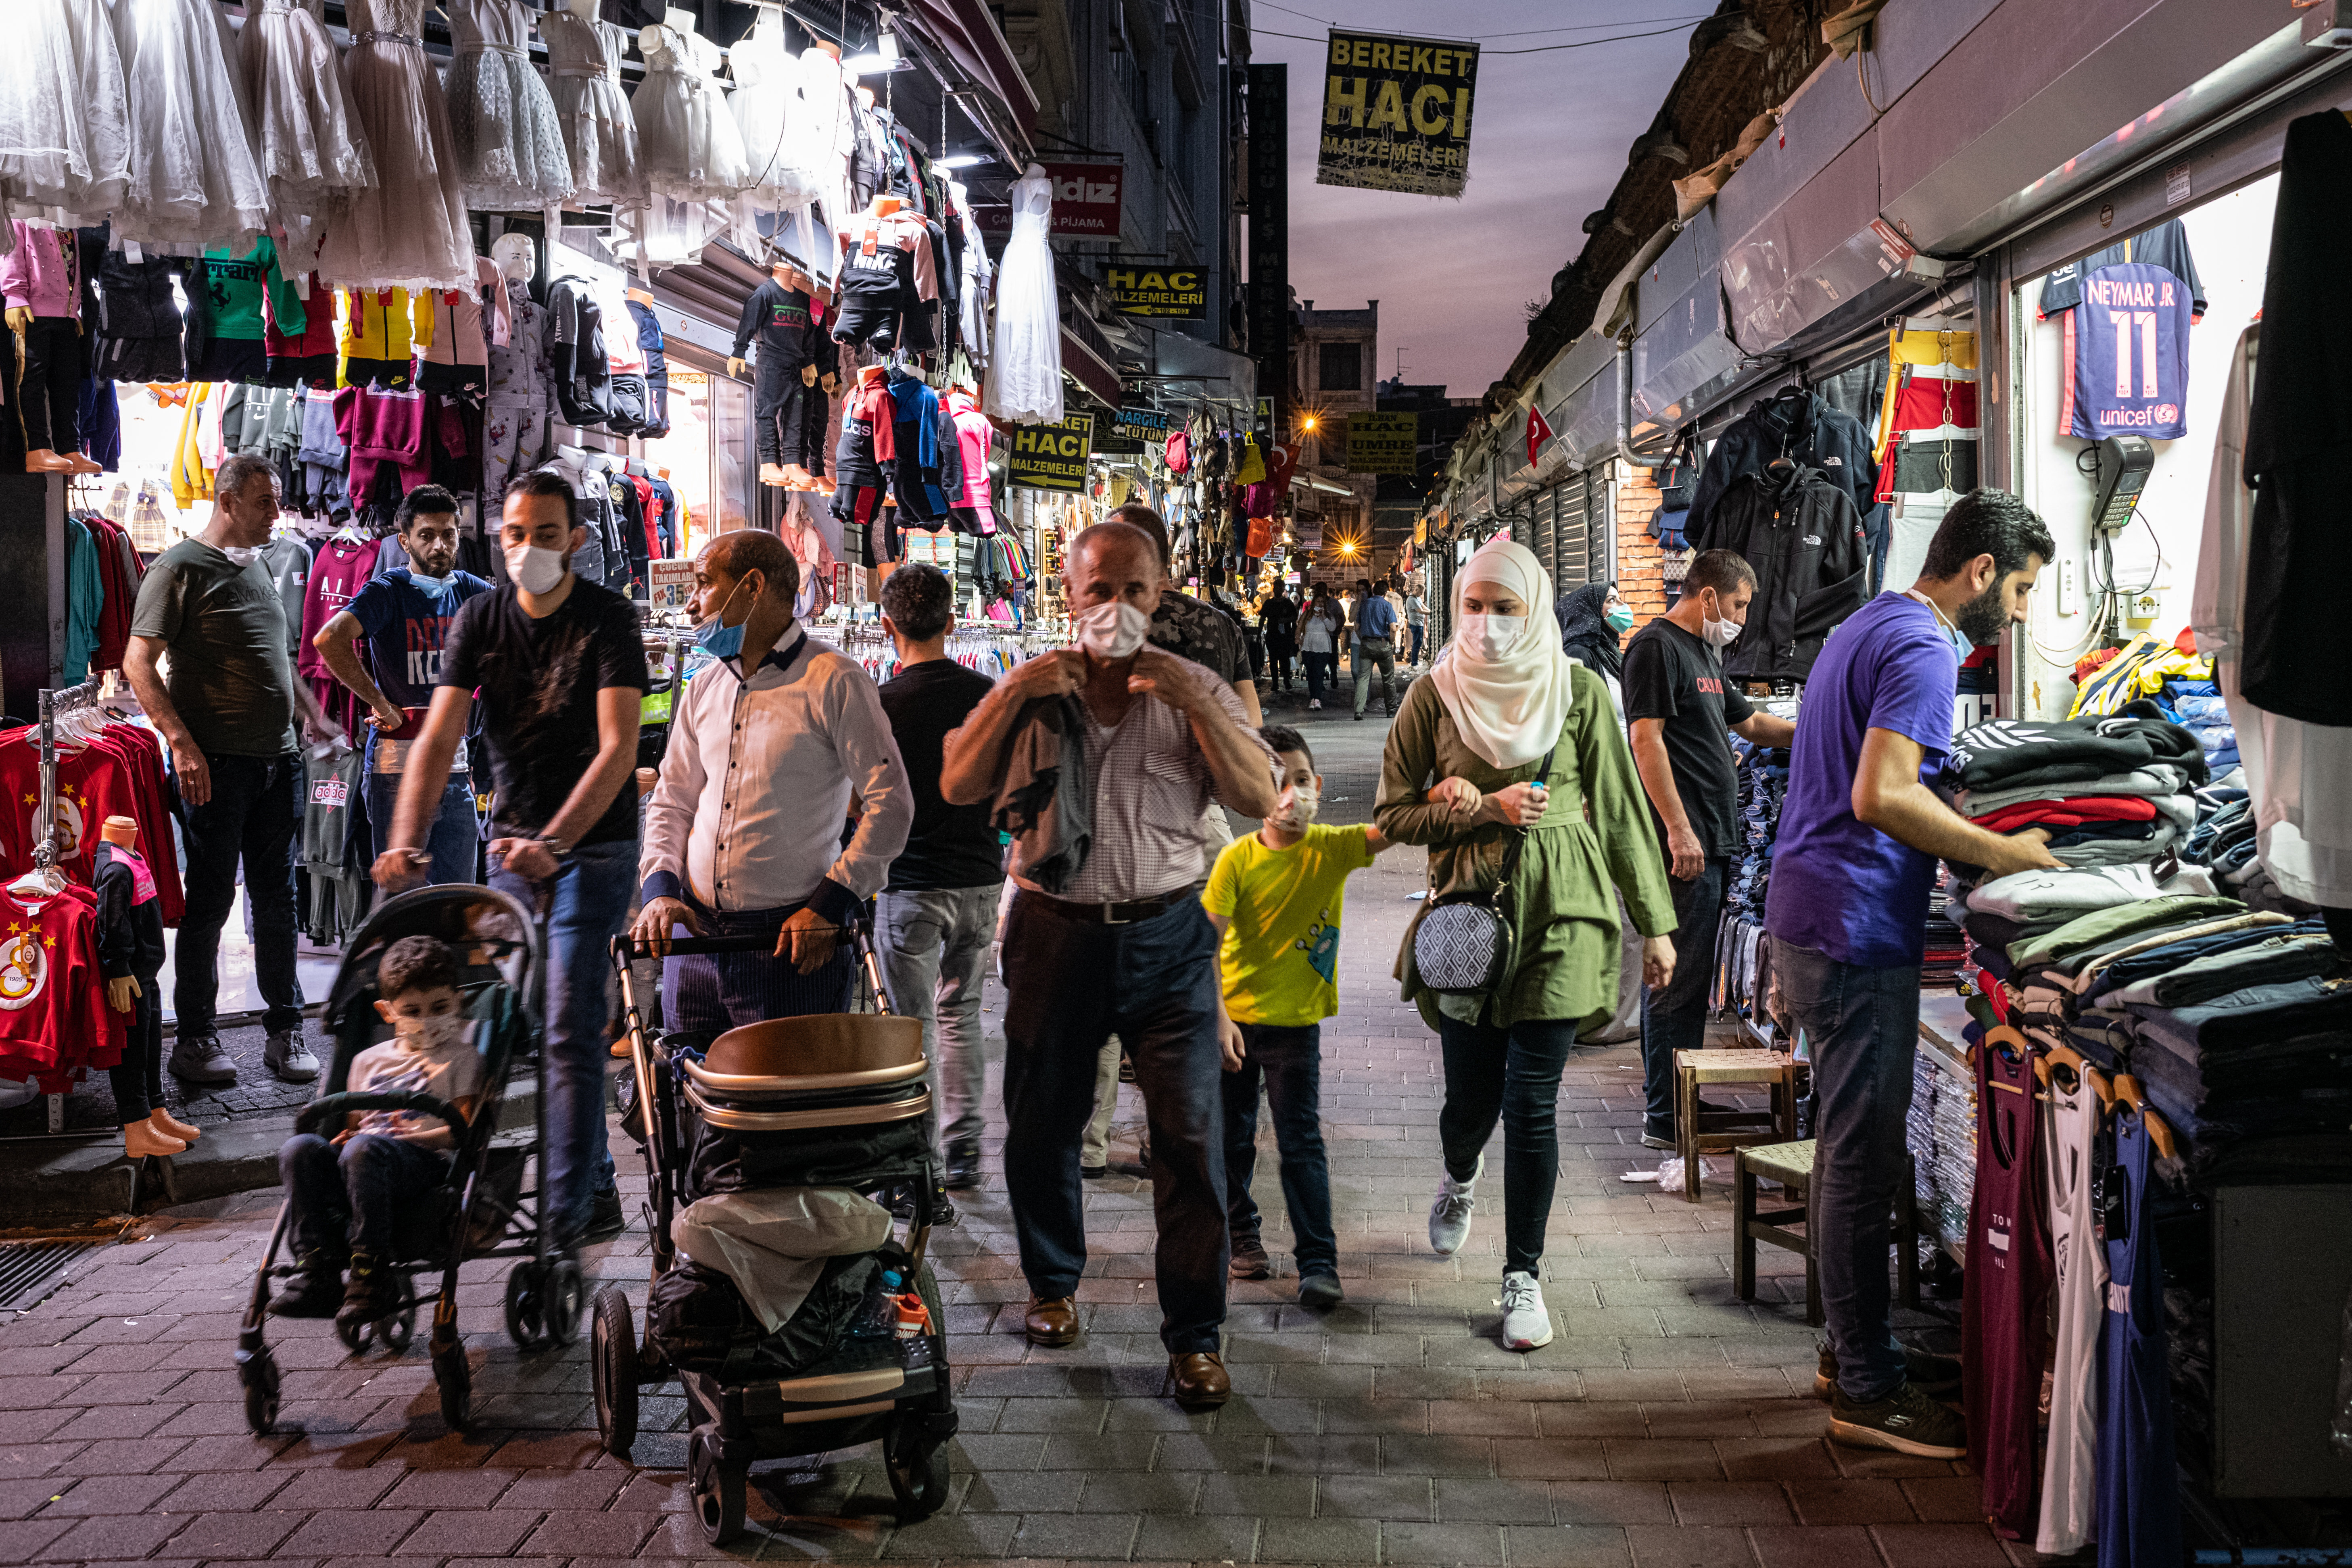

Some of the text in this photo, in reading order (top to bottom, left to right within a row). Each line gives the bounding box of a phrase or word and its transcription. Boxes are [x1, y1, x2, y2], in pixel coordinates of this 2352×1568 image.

[1331, 39, 1472, 77] BEREKET
[1326, 75, 1469, 138] HACI
[1323, 136, 1464, 167] MALZEMELERİ
[1061, 215, 1105, 228] PİJAMA
[852, 248, 898, 274] NIKE
[205, 263, 260, 282] rrari
[1108, 269, 1197, 291] HAC
[1109, 290, 1203, 305] ALZEMELERİ
[2088, 280, 2175, 307] NEYMAR JR
[2109, 311, 2158, 398] 11
[576, 377, 590, 401] NIKE
[2100, 405, 2154, 426] unicef
[1125, 424, 1166, 442] TÜTÜN
[1351, 423, 1413, 431] HAC
[1015, 430, 1088, 458] HACI
[1352, 440, 1413, 449] UMRE
[1011, 458, 1086, 477] MALZEMELERİ
[654, 572, 693, 584] TAKIMLARI
[659, 562, 689, 573] ÇOCUK
[654, 588, 666, 604] FIX
[666, 584, 684, 605] 35
